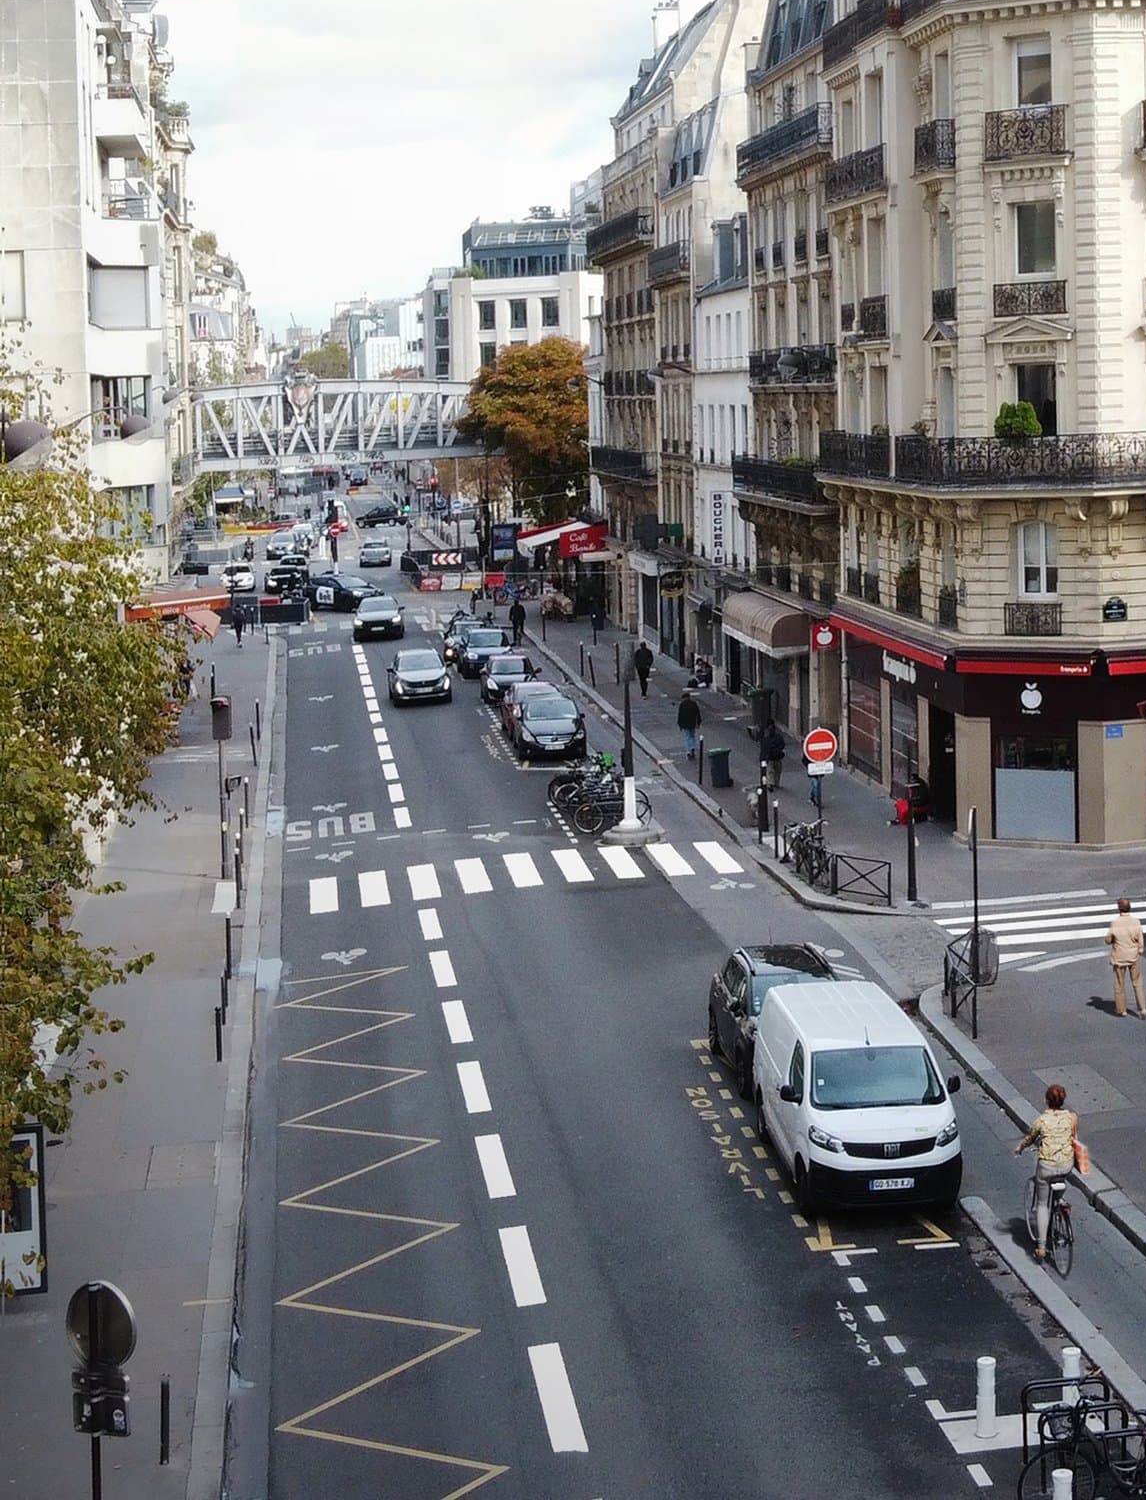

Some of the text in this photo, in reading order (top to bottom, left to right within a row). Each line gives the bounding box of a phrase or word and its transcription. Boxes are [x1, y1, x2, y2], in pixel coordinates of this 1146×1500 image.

[713, 493, 723, 564] BOUCHERIE
[286, 811, 376, 841] BUS
[685, 1086, 765, 1199] LIVRAISON
[836, 1300, 881, 1366] PAYANT
